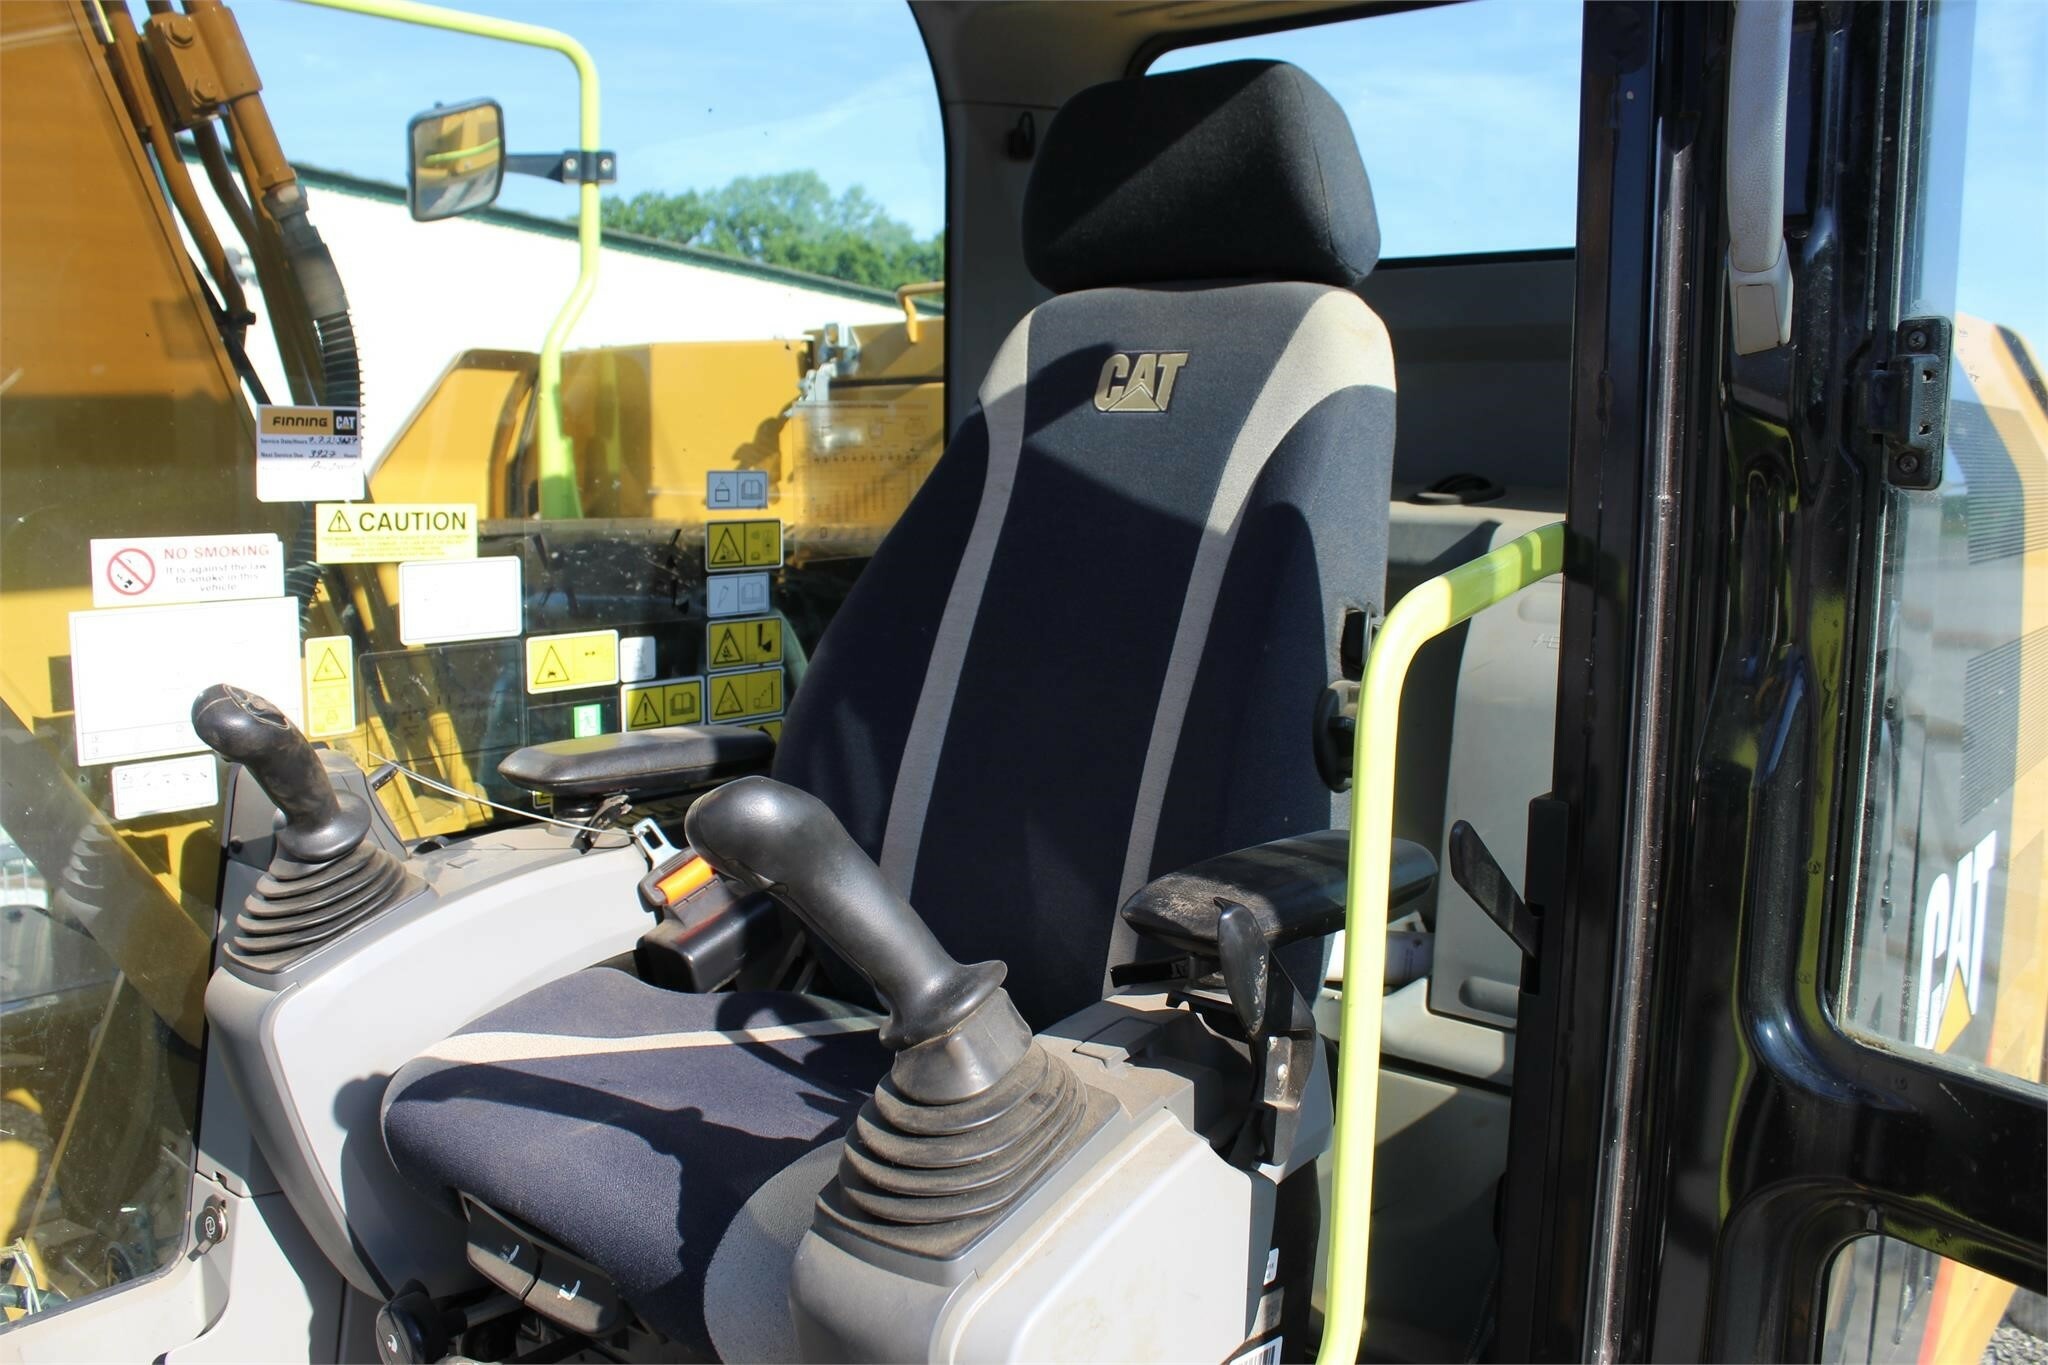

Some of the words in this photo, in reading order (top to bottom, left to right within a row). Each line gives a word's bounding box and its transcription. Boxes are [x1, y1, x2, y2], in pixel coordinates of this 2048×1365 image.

[1094, 351, 1189, 412] CAT
[272, 416, 328, 427] FINNING
[335, 415, 355, 430] CAT
[359, 512, 466, 532] CAUTION
[163, 547, 188, 560] NO
[193, 544, 270, 559] SMOKING
[165, 566, 173, 575] It
[176, 566, 186, 574] is
[189, 564, 228, 575] against
[231, 563, 247, 571] the
[249, 562, 267, 570] law
[175, 576, 186, 584] to
[190, 574, 225, 583] smoke
[239, 573, 259, 581] this
[200, 583, 238, 592] vehicle
[1914, 830, 1997, 1050] CAT
